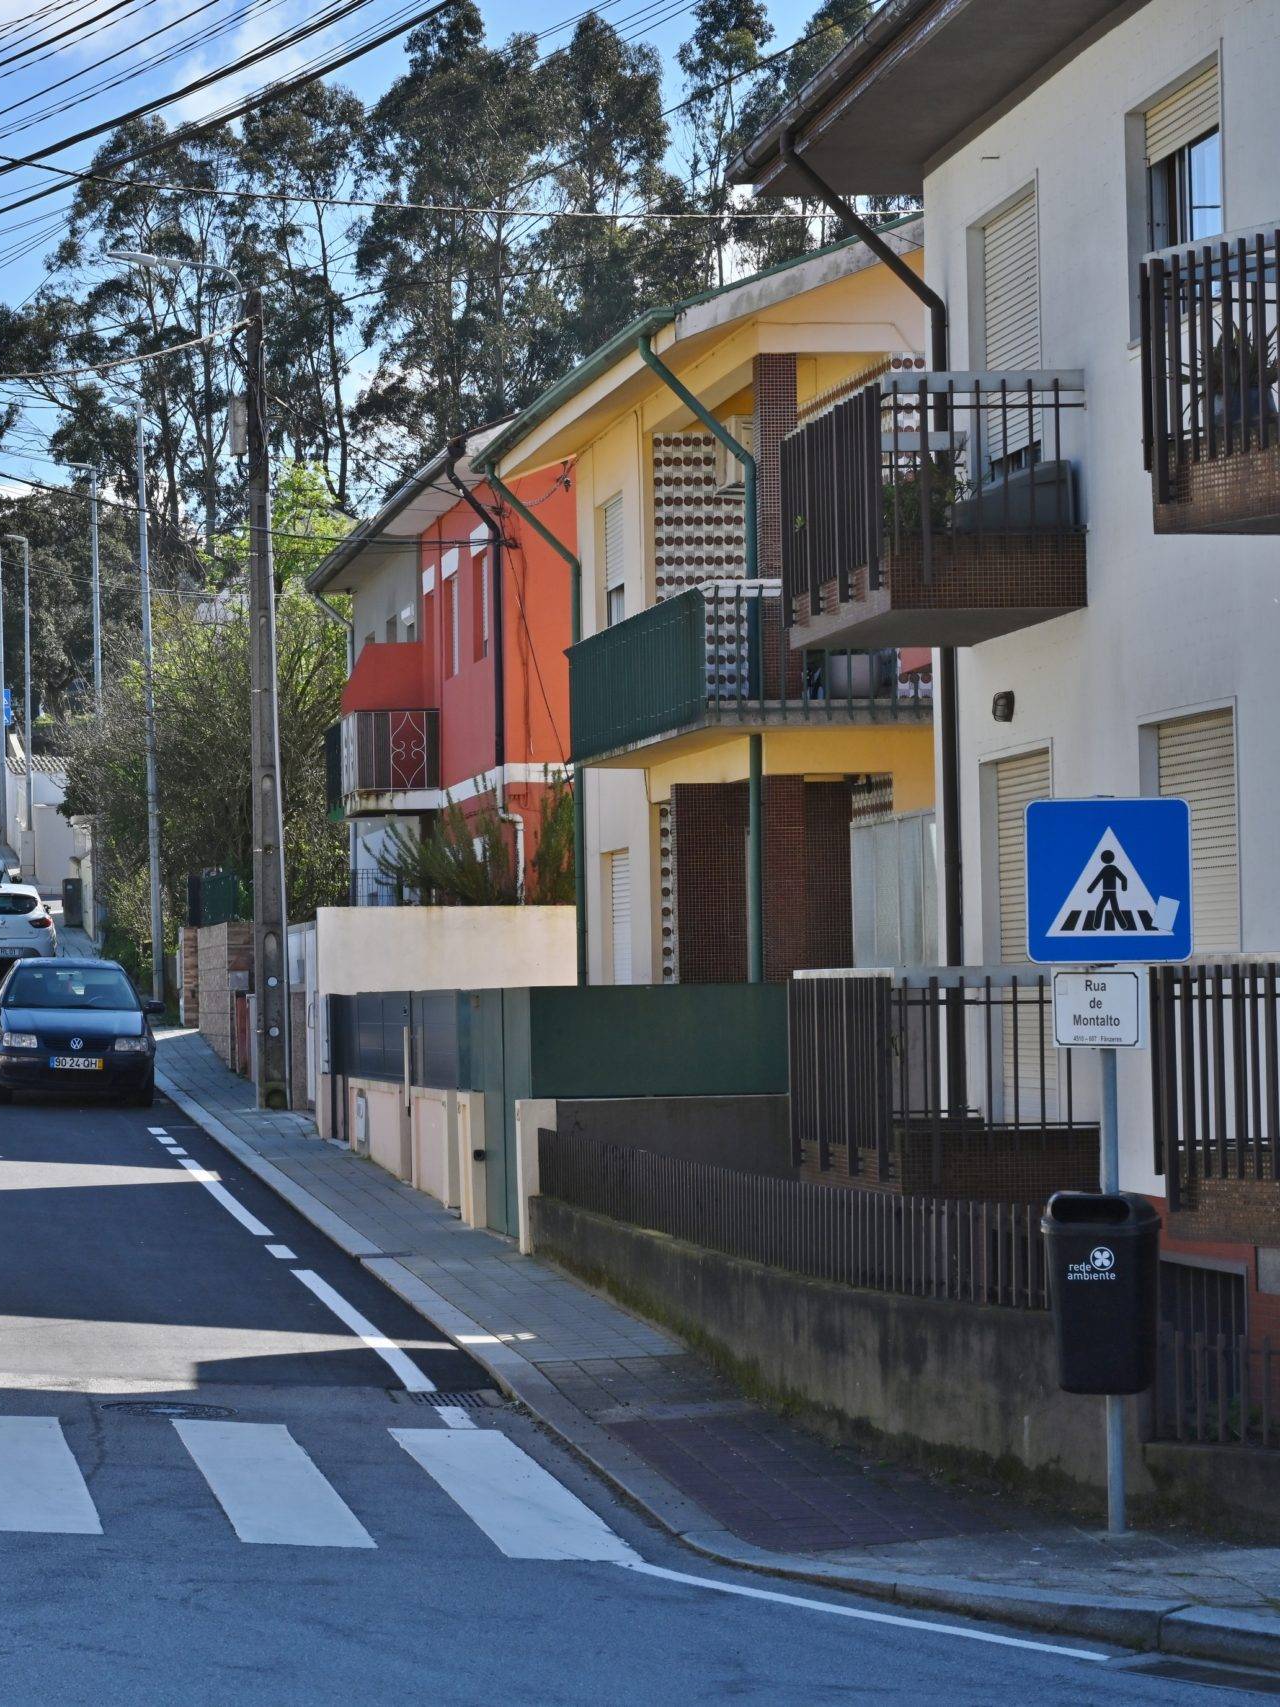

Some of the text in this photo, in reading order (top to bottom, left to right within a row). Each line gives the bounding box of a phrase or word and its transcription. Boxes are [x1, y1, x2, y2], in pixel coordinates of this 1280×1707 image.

[1085, 979, 1107, 992] Rua
[1089, 997, 1103, 1009] de
[1073, 1014, 1121, 1027] Montalto
[1068, 1261, 1092, 1271] rede
[1067, 1271, 1116, 1280] ambiente
